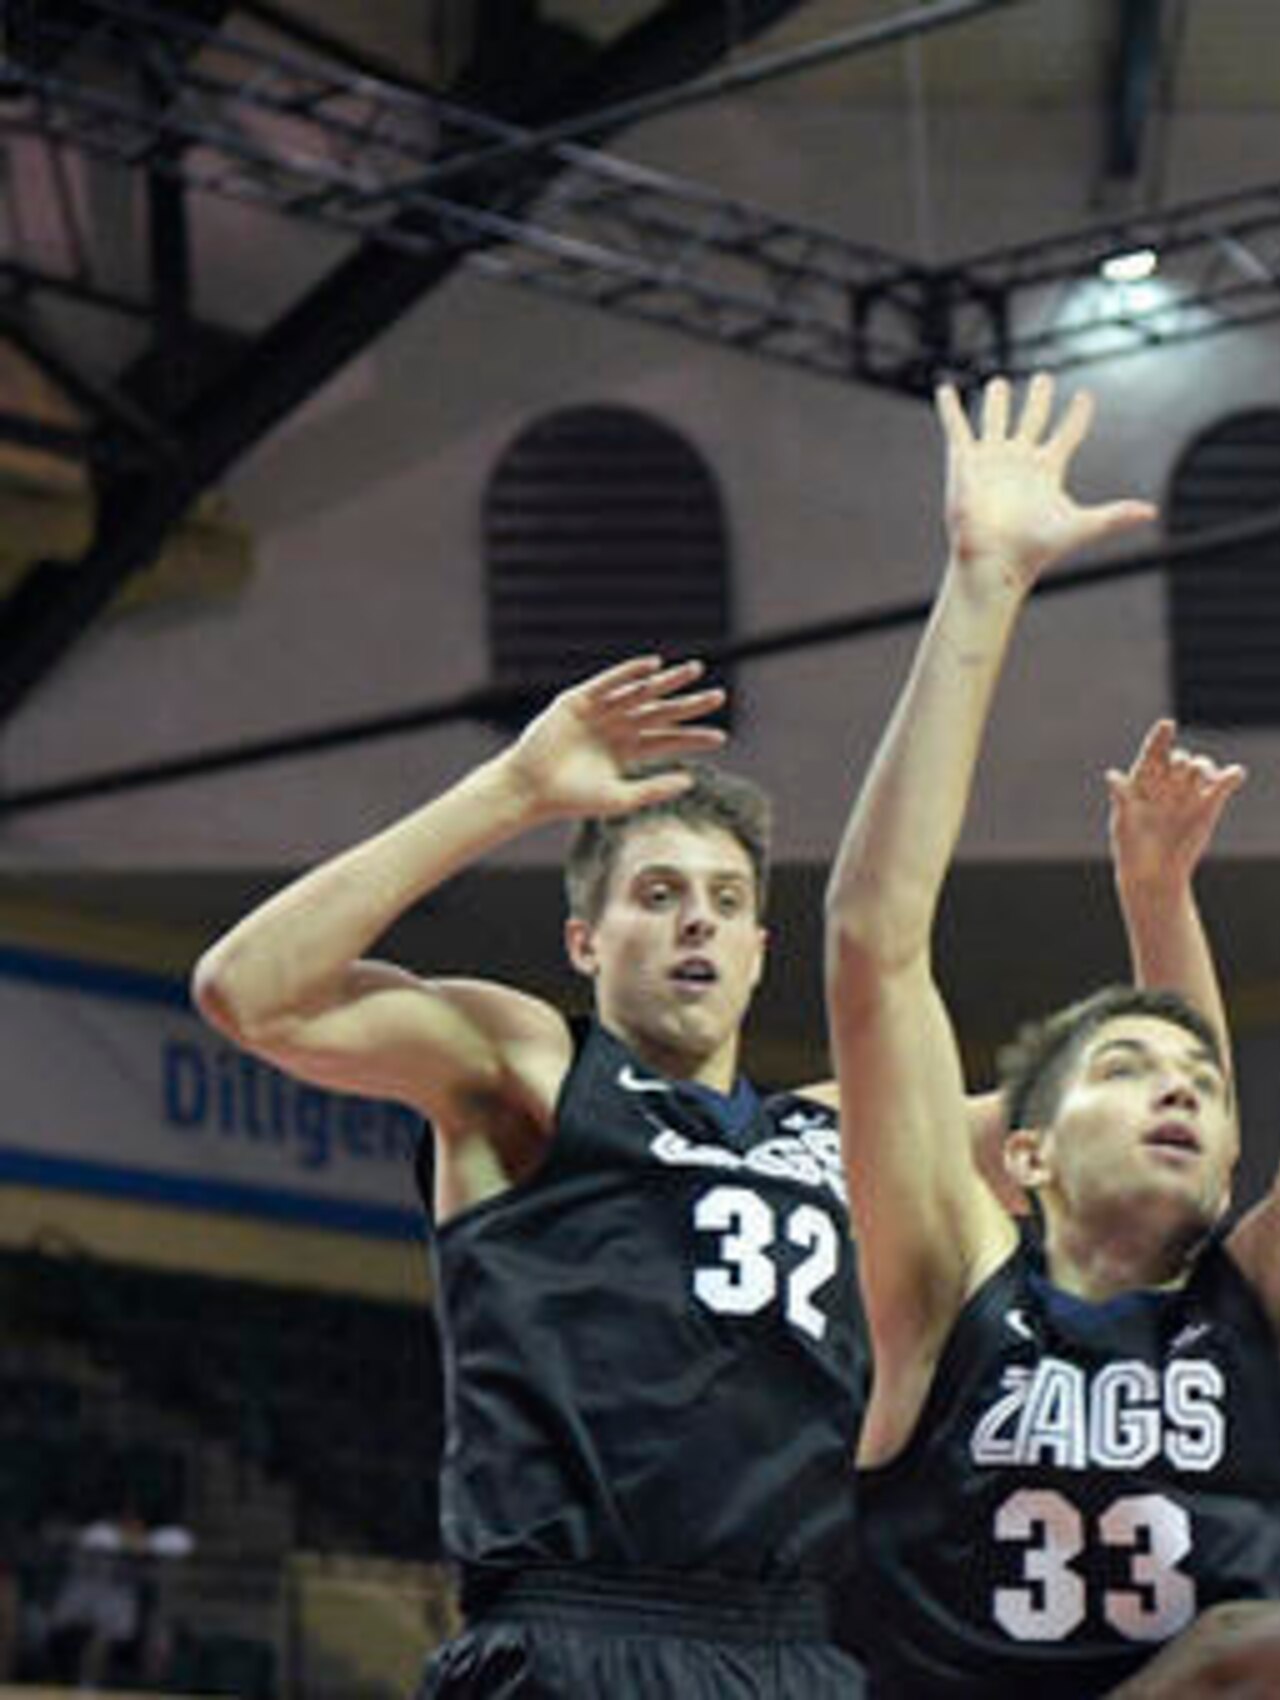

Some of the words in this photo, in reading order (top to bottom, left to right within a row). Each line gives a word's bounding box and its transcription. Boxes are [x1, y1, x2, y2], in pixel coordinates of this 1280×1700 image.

[693, 1184, 840, 1341] 32
[970, 1356, 1225, 1471] ZAGS
[994, 1489, 1197, 1641] 33
